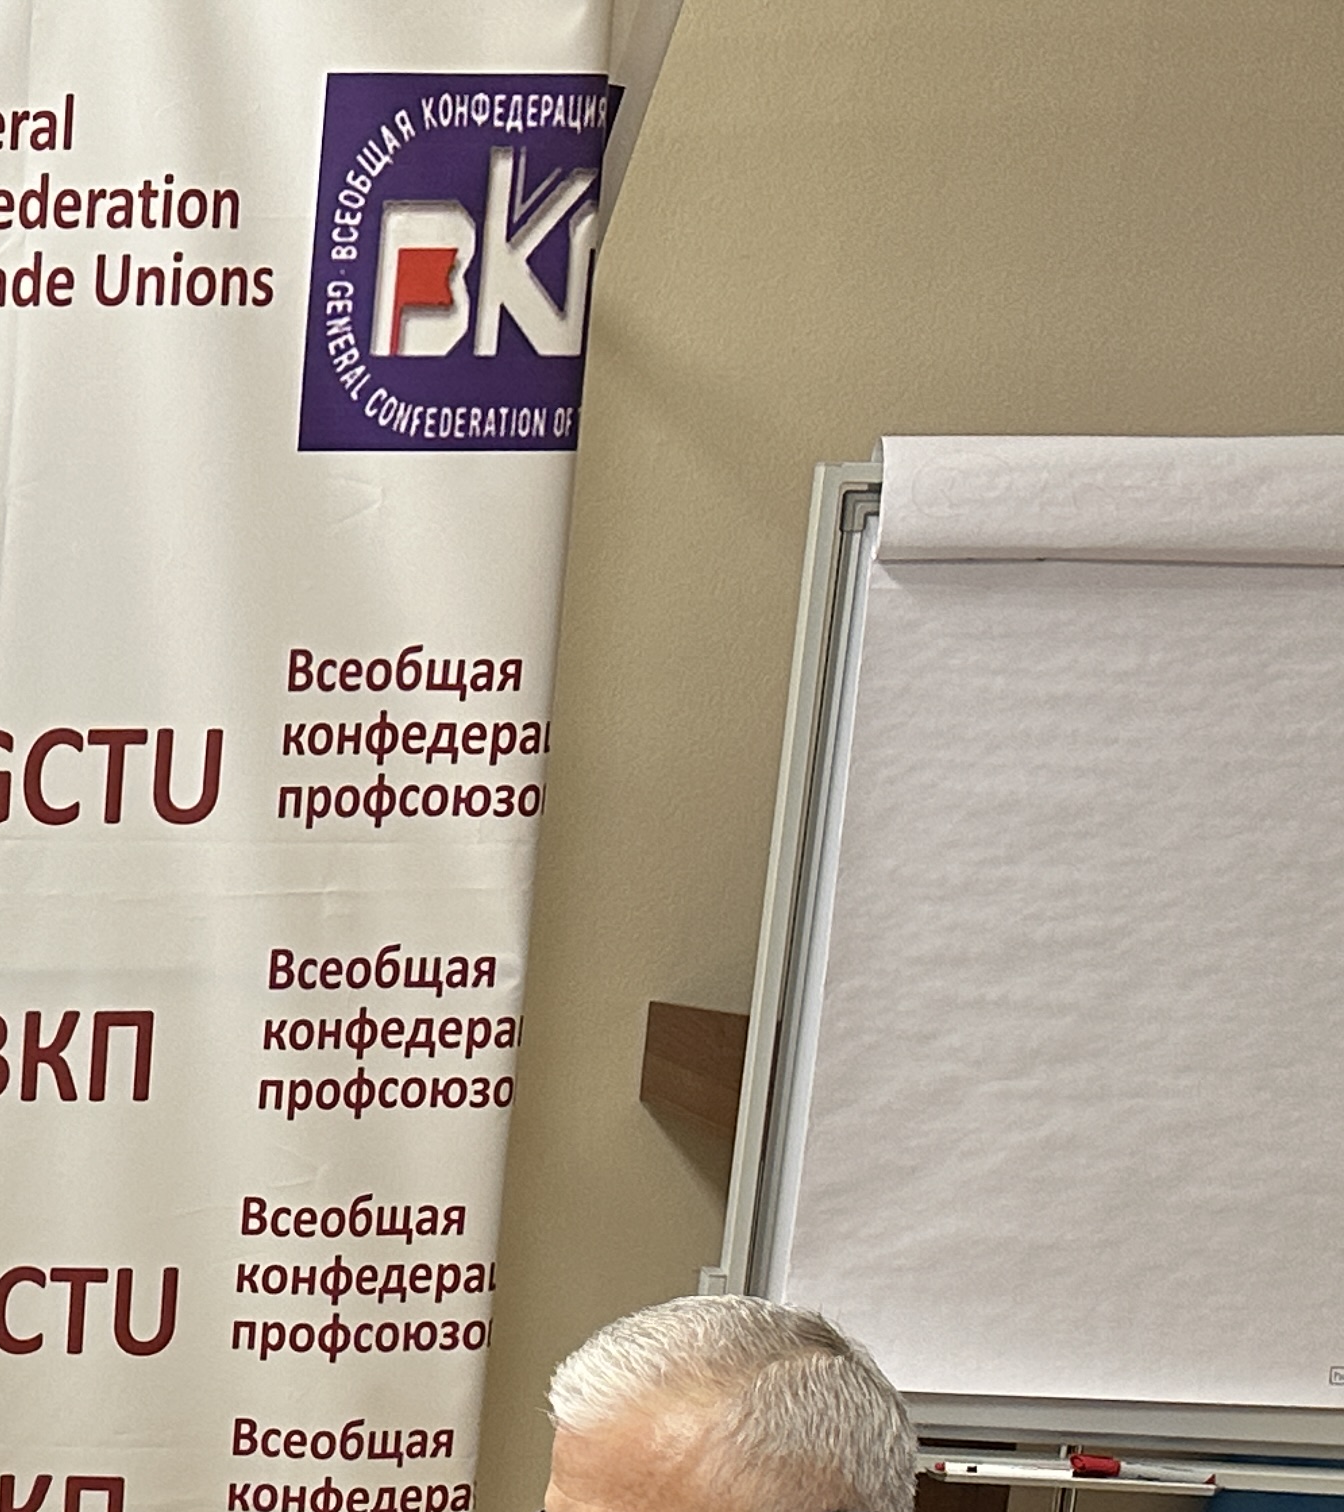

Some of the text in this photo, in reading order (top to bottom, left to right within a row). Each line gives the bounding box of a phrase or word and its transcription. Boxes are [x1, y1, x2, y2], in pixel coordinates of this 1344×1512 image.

[331, 109, 416, 260] ВСЕОБЩАЯ
[94, 253, 274, 308] Unions
[326, 281, 573, 438] GENERAL CONFEDERATION OF
[287, 644, 523, 702] Всеобщая
[282, 711, 551, 766] конфедера
[278, 774, 546, 828] профсоюзо
[268, 943, 497, 998] Всеобщая
[262, 1007, 523, 1059] конфедера
[258, 1068, 516, 1120] профсоюзо
[240, 1193, 467, 1245] Всеобщая
[235, 1256, 496, 1306] конфедера
[231, 1313, 493, 1363] профсоюзо
[231, 1417, 454, 1467] Всеобщая
